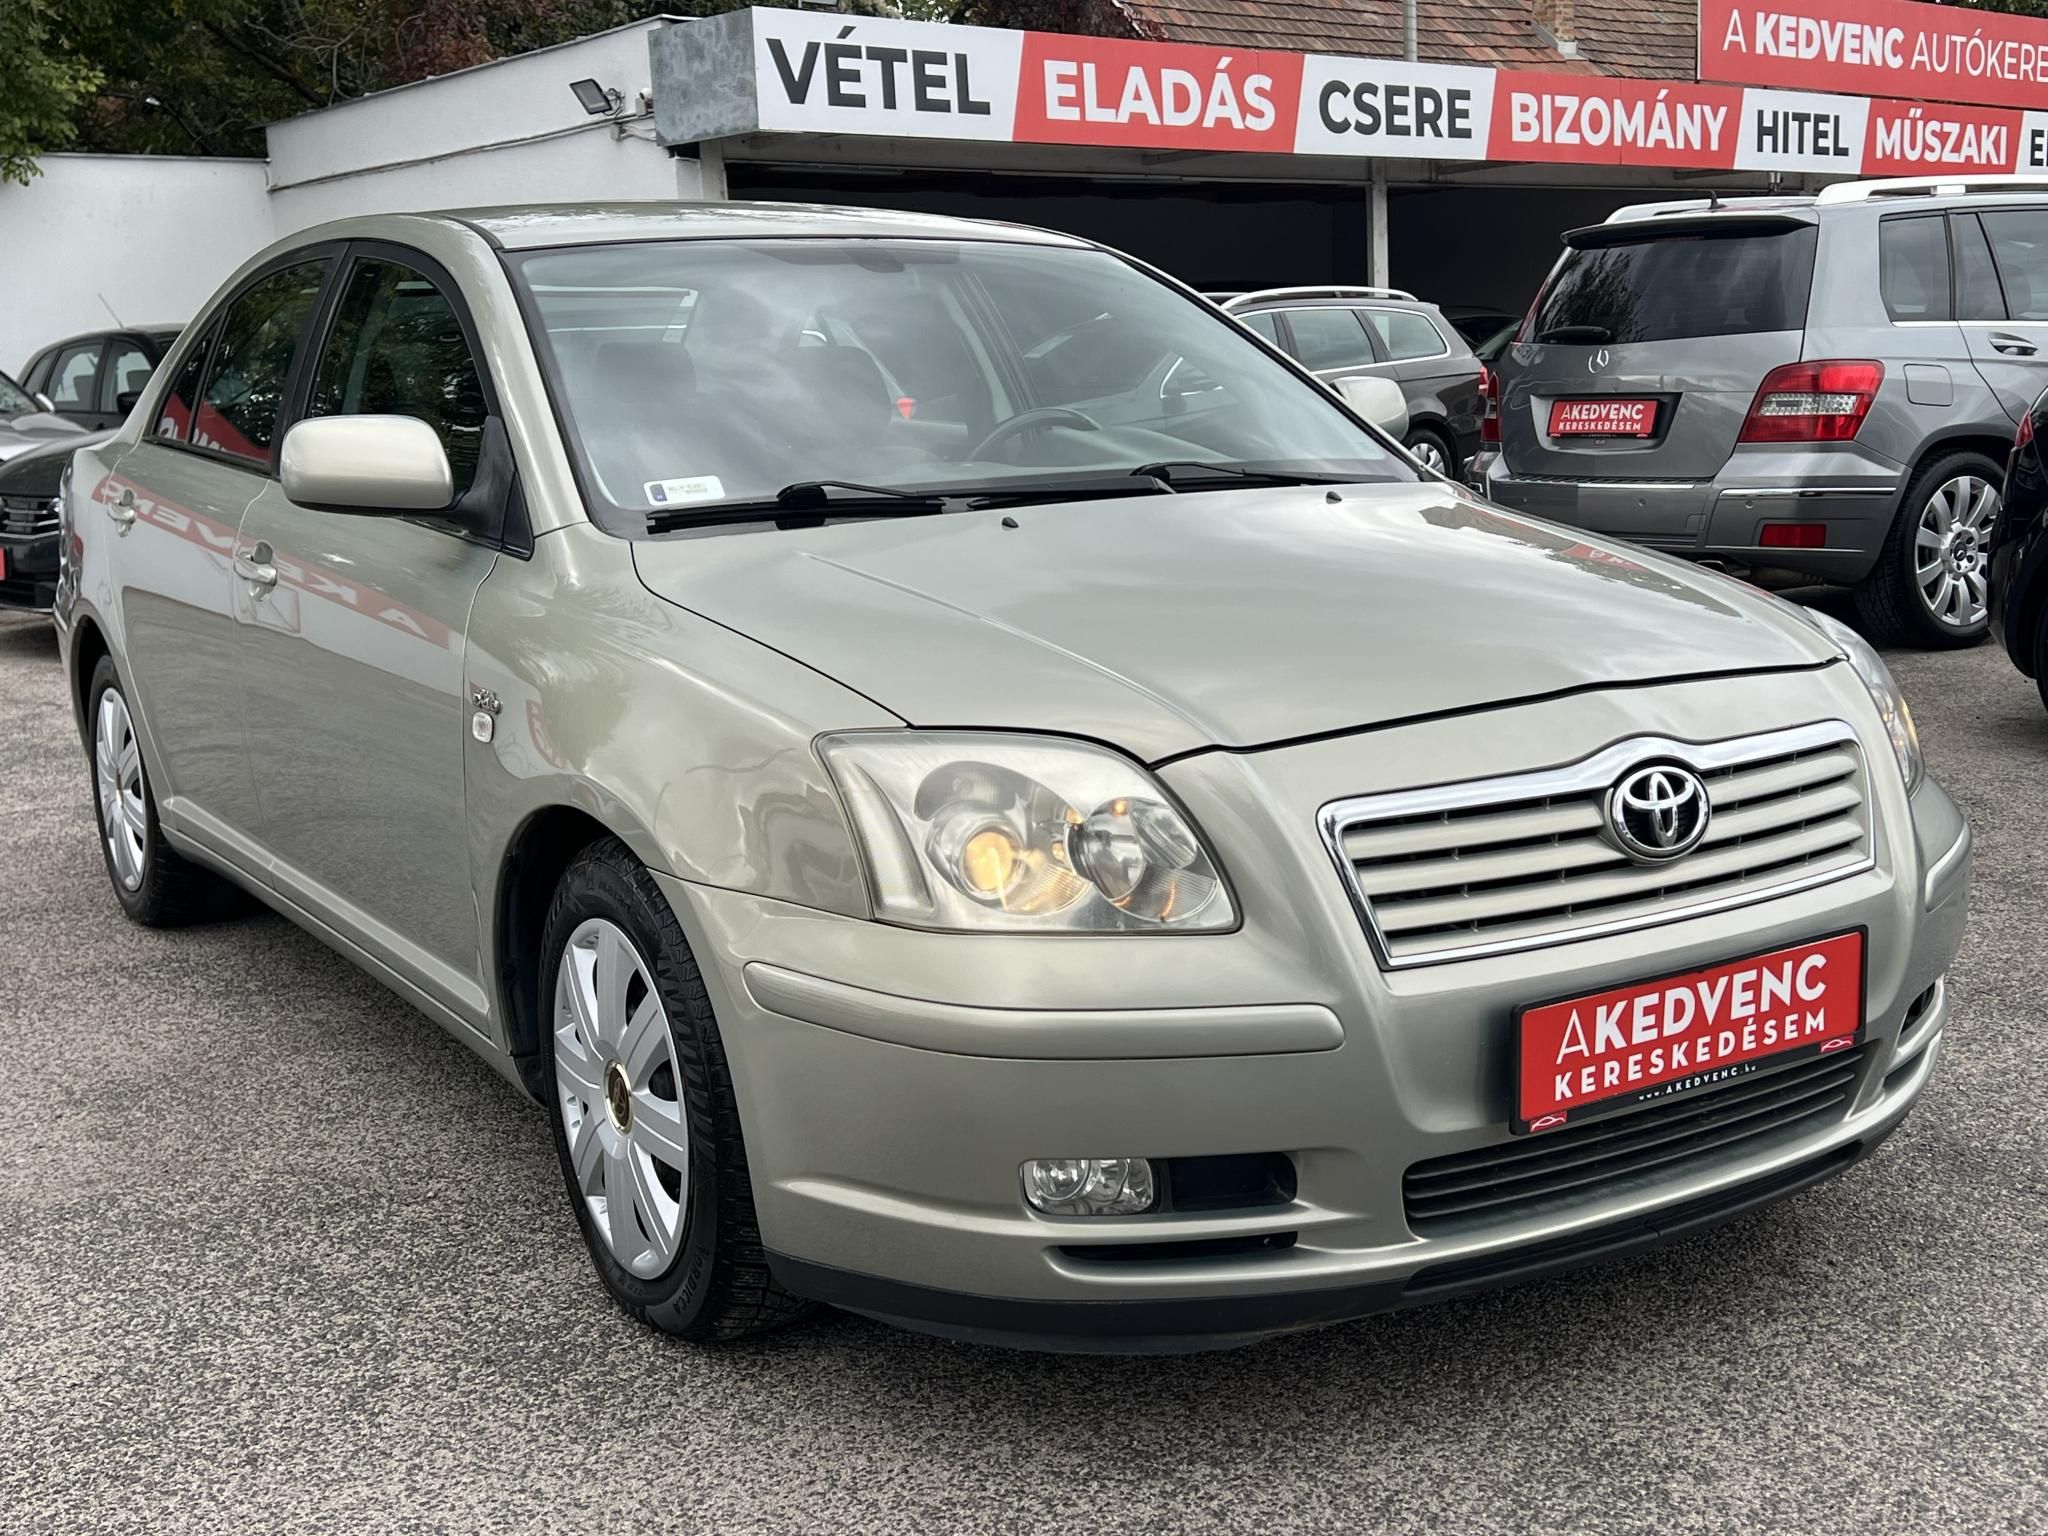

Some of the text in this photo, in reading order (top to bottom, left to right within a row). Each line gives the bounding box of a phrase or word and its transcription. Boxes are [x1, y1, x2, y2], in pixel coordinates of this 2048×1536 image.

[1723, 9, 1747, 53] A
[1756, 12, 1905, 69] KEDVENC
[765, 26, 991, 116] VÉTEL
[1044, 57, 1275, 131] ELADÁS
[1319, 80, 1472, 138] CSERE
[1511, 89, 1727, 151] BIZOMÁNY
[1757, 110, 1849, 156] HITEL
[1876, 108, 2007, 165] MŰSZAKI
[1559, 419, 1641, 431] KERESKEDÉSEM
[1555, 1008, 1826, 1101] KERESKEDÉSEM
